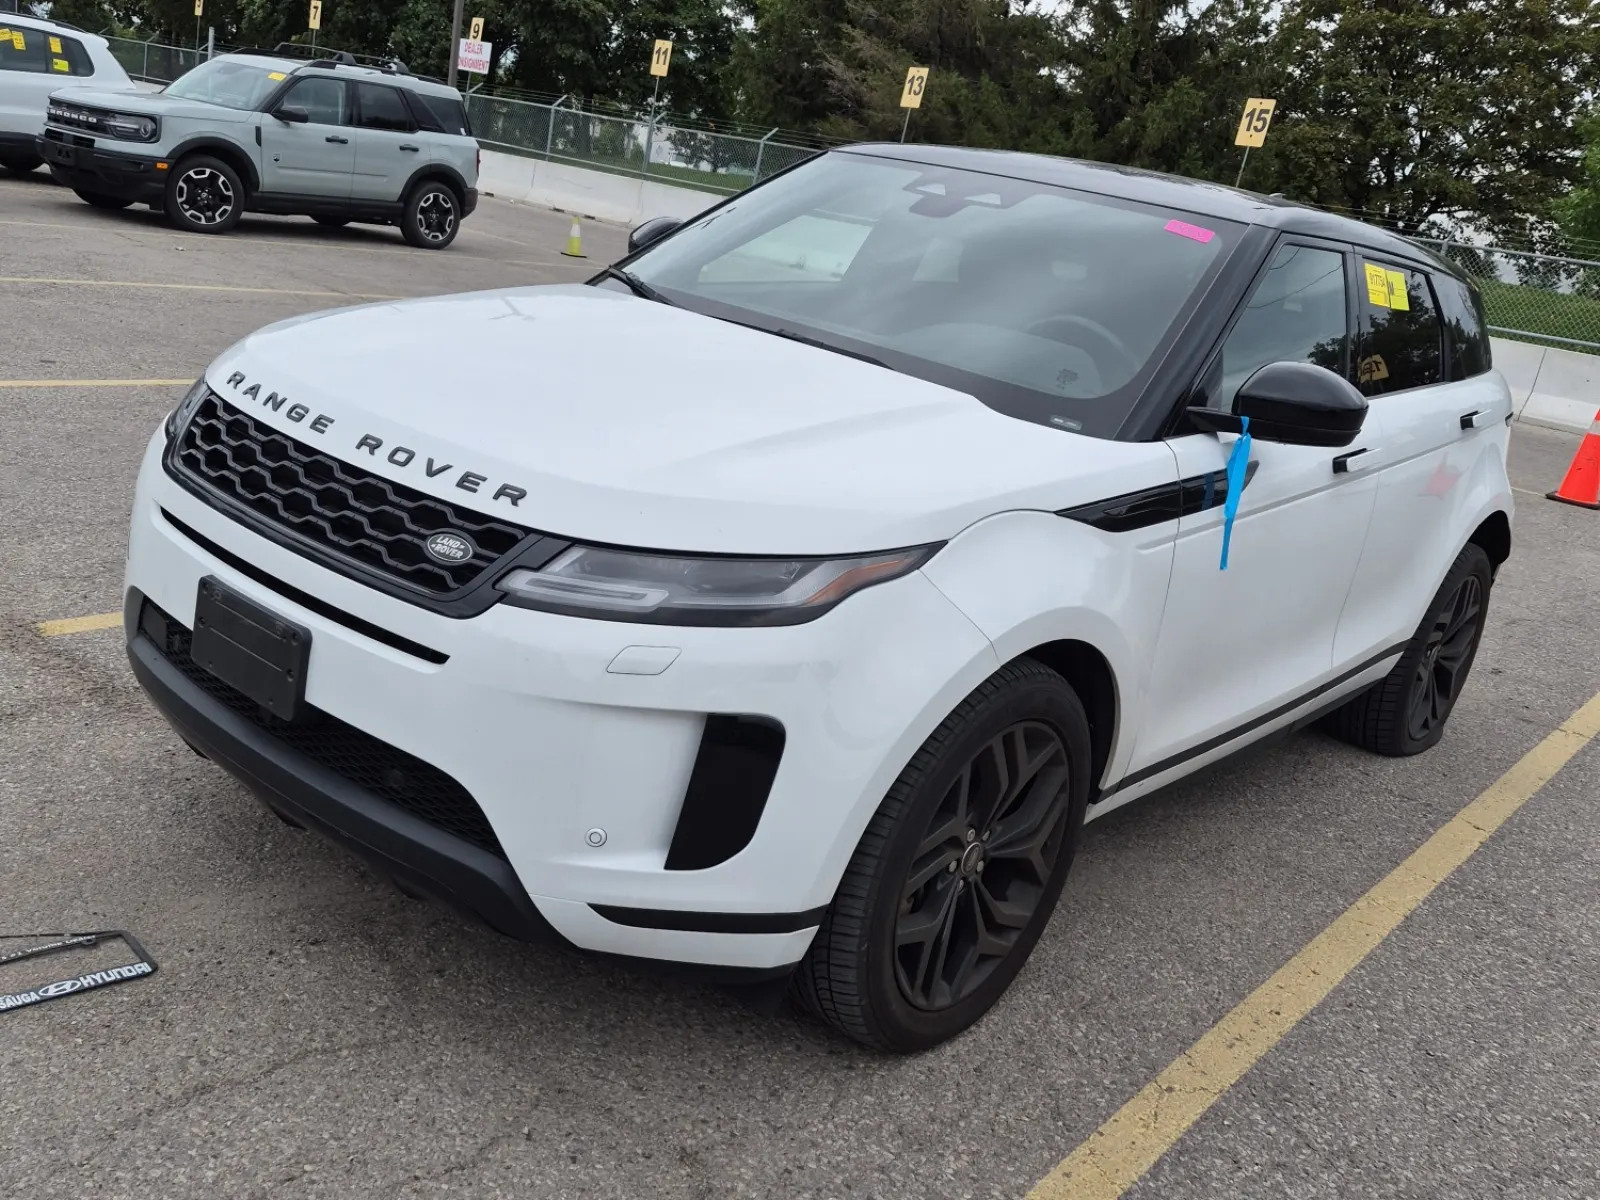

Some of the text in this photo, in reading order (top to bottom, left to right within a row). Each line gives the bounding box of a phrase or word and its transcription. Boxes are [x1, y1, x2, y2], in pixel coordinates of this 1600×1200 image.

[312, 5, 319, 20] 7
[472, 23, 480, 39] 9
[464, 41, 484, 55] DEALER
[655, 46, 669, 65] 11
[907, 74, 924, 96] 13
[50, 108, 97, 123] BRONCO
[1245, 107, 1271, 133] 15
[226, 370, 527, 507] RANGE ROVER
[436, 535, 461, 548] LAND
[434, 543, 464, 559] ROVER
[79, 962, 153, 987] HYUNDAI
